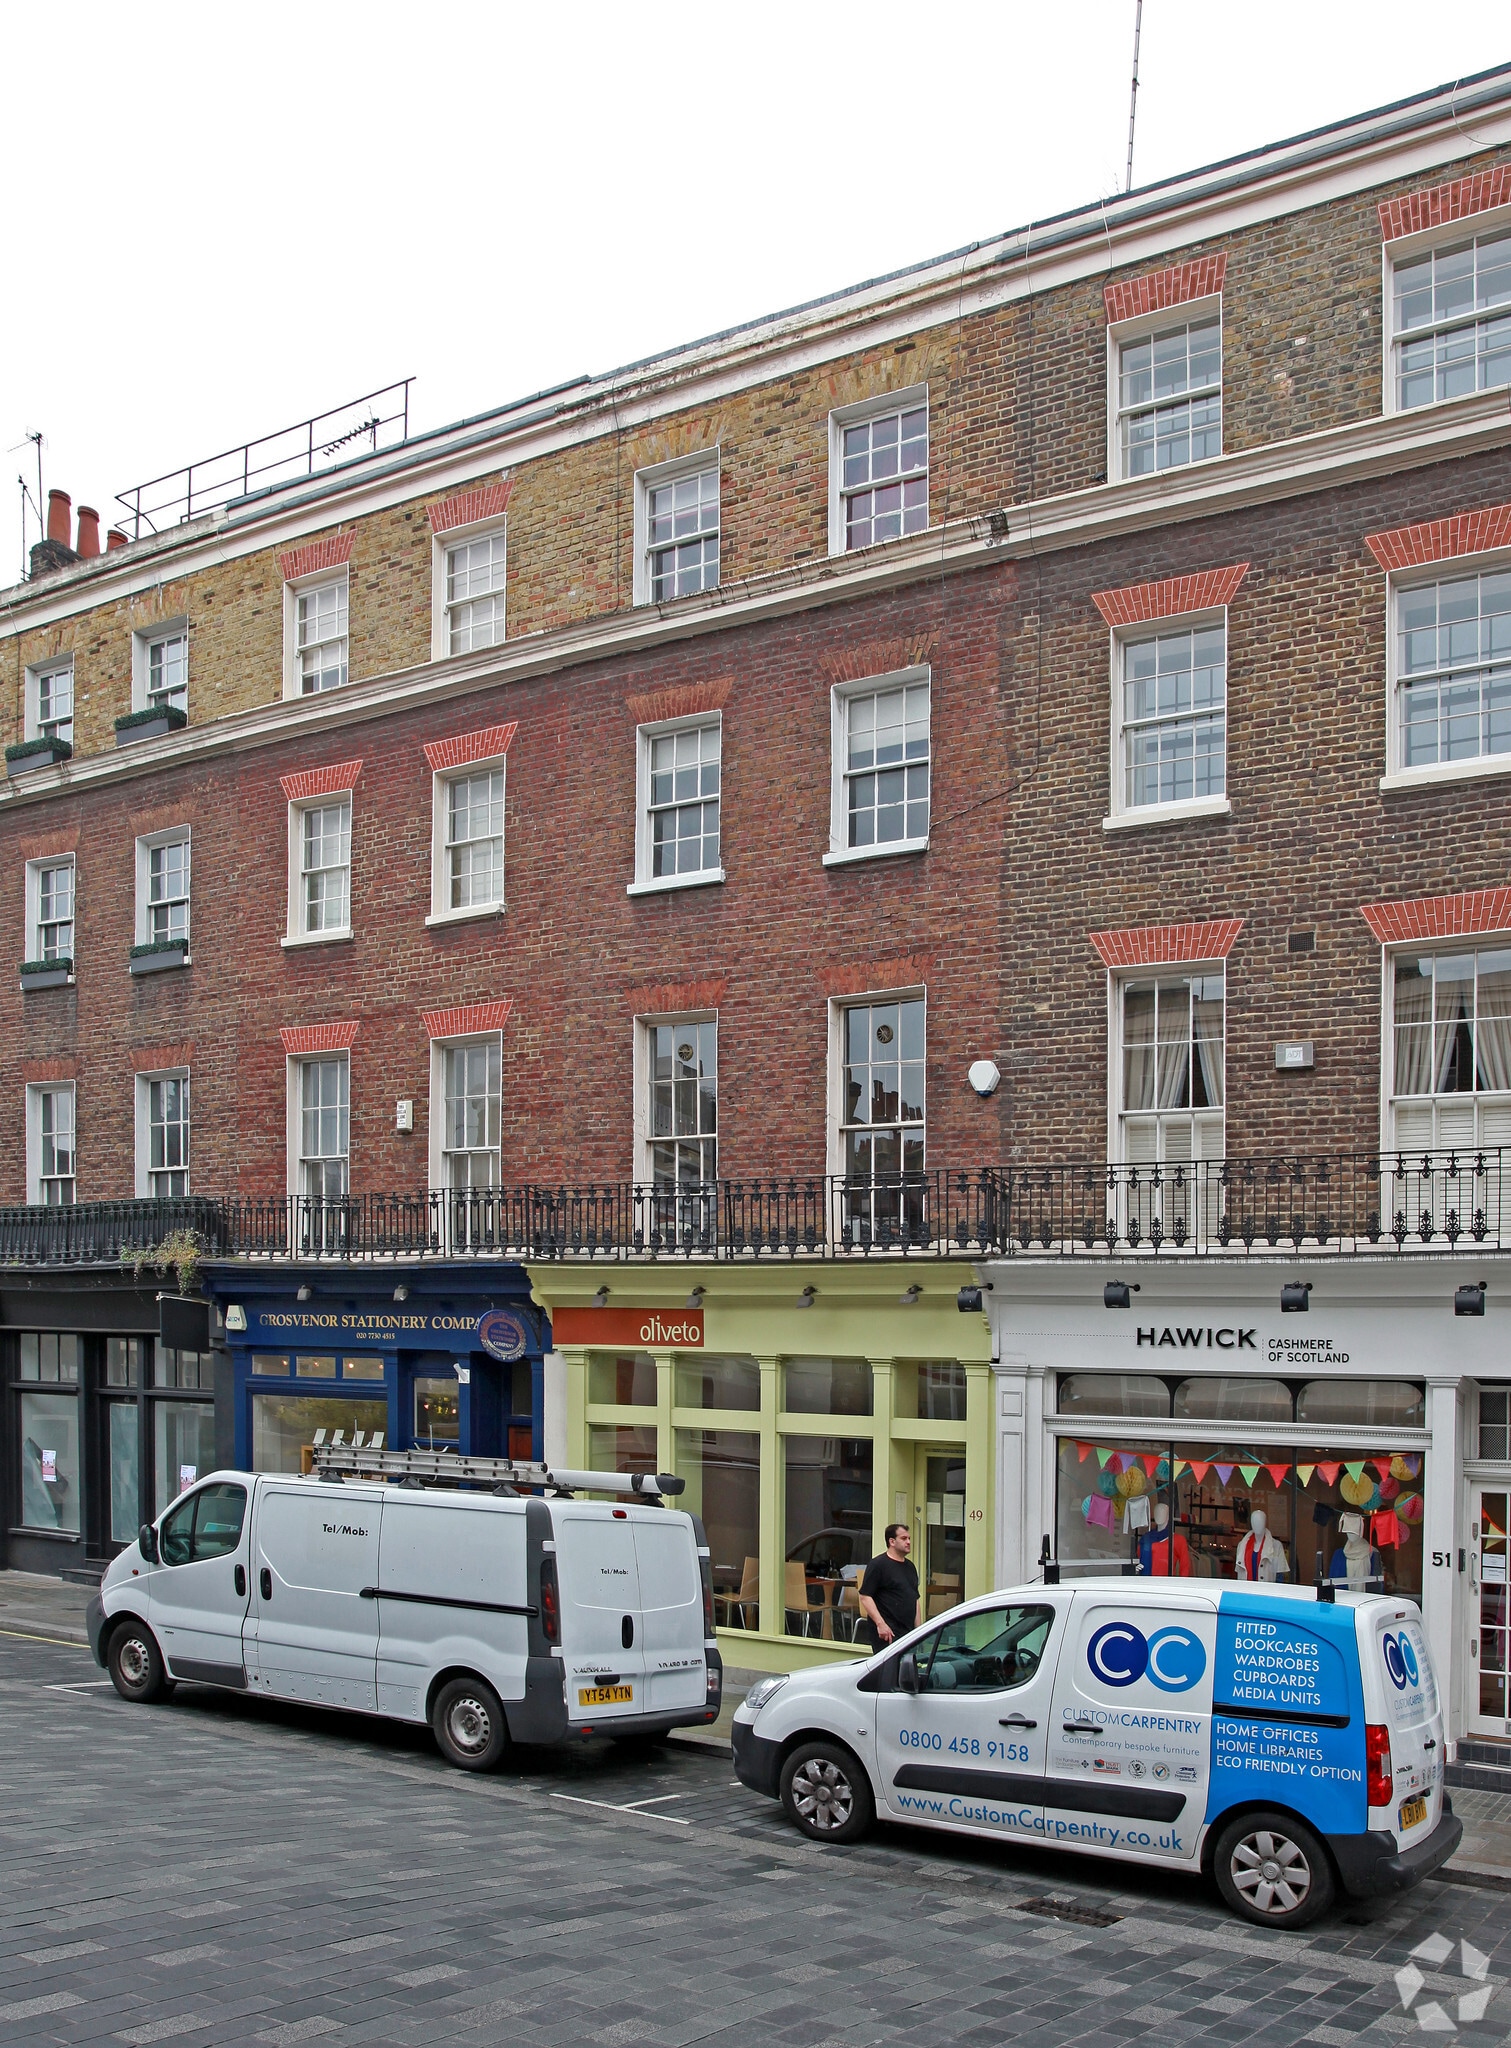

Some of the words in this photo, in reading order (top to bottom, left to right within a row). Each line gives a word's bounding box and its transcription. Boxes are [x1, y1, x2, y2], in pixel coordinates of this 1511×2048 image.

[260, 1313, 338, 1328] GROSVENOR
[341, 1314, 429, 1330] STATIONERY
[431, 1316, 480, 1330] COMPA
[640, 1315, 700, 1342] oliveto
[368, 1332, 381, 1340] 7730
[382, 1332, 395, 1340] 4515
[1136, 1326, 1257, 1348] HAWICK
[1268, 1338, 1333, 1350] CASHMERE
[1268, 1351, 1284, 1362] OF
[1287, 1352, 1350, 1364] SCOTLAND
[969, 1509, 983, 1522] 49
[322, 1523, 369, 1536] Tel/Mob:
[1431, 1551, 1451, 1568] 51
[1236, 1621, 1277, 1636] FITTED
[1234, 1637, 1319, 1656] BOOKCASES
[1234, 1653, 1320, 1672] WARDROBES
[1233, 1669, 1316, 1688] CUPBOARDS
[585, 1688, 611, 1702] YT54
[612, 1686, 631, 1700] YTN
[1232, 1685, 1277, 1701] MEDIA
[1281, 1690, 1321, 1705] UNITS
[1062, 1707, 1201, 1735] CUSTOMCARPENTRY
[1216, 1722, 1259, 1738] HOME
[1263, 1727, 1319, 1744] OFFICES
[899, 1729, 942, 1750] 0800
[948, 1736, 980, 1756] 458
[987, 1740, 1029, 1763] 9158
[1062, 1734, 1122, 1750] Contemporary
[1124, 1741, 1160, 1753] bespoke
[1163, 1744, 1200, 1756] furniture
[1216, 1738, 1256, 1754] HOME
[1260, 1743, 1323, 1761] LIBRARIES
[1216, 1755, 1242, 1768] ECO
[1245, 1758, 1307, 1776] FRIENDLY
[1310, 1765, 1362, 1782] OPTION
[897, 1795, 1183, 1850] www.CustomCarpentry.co.uk
